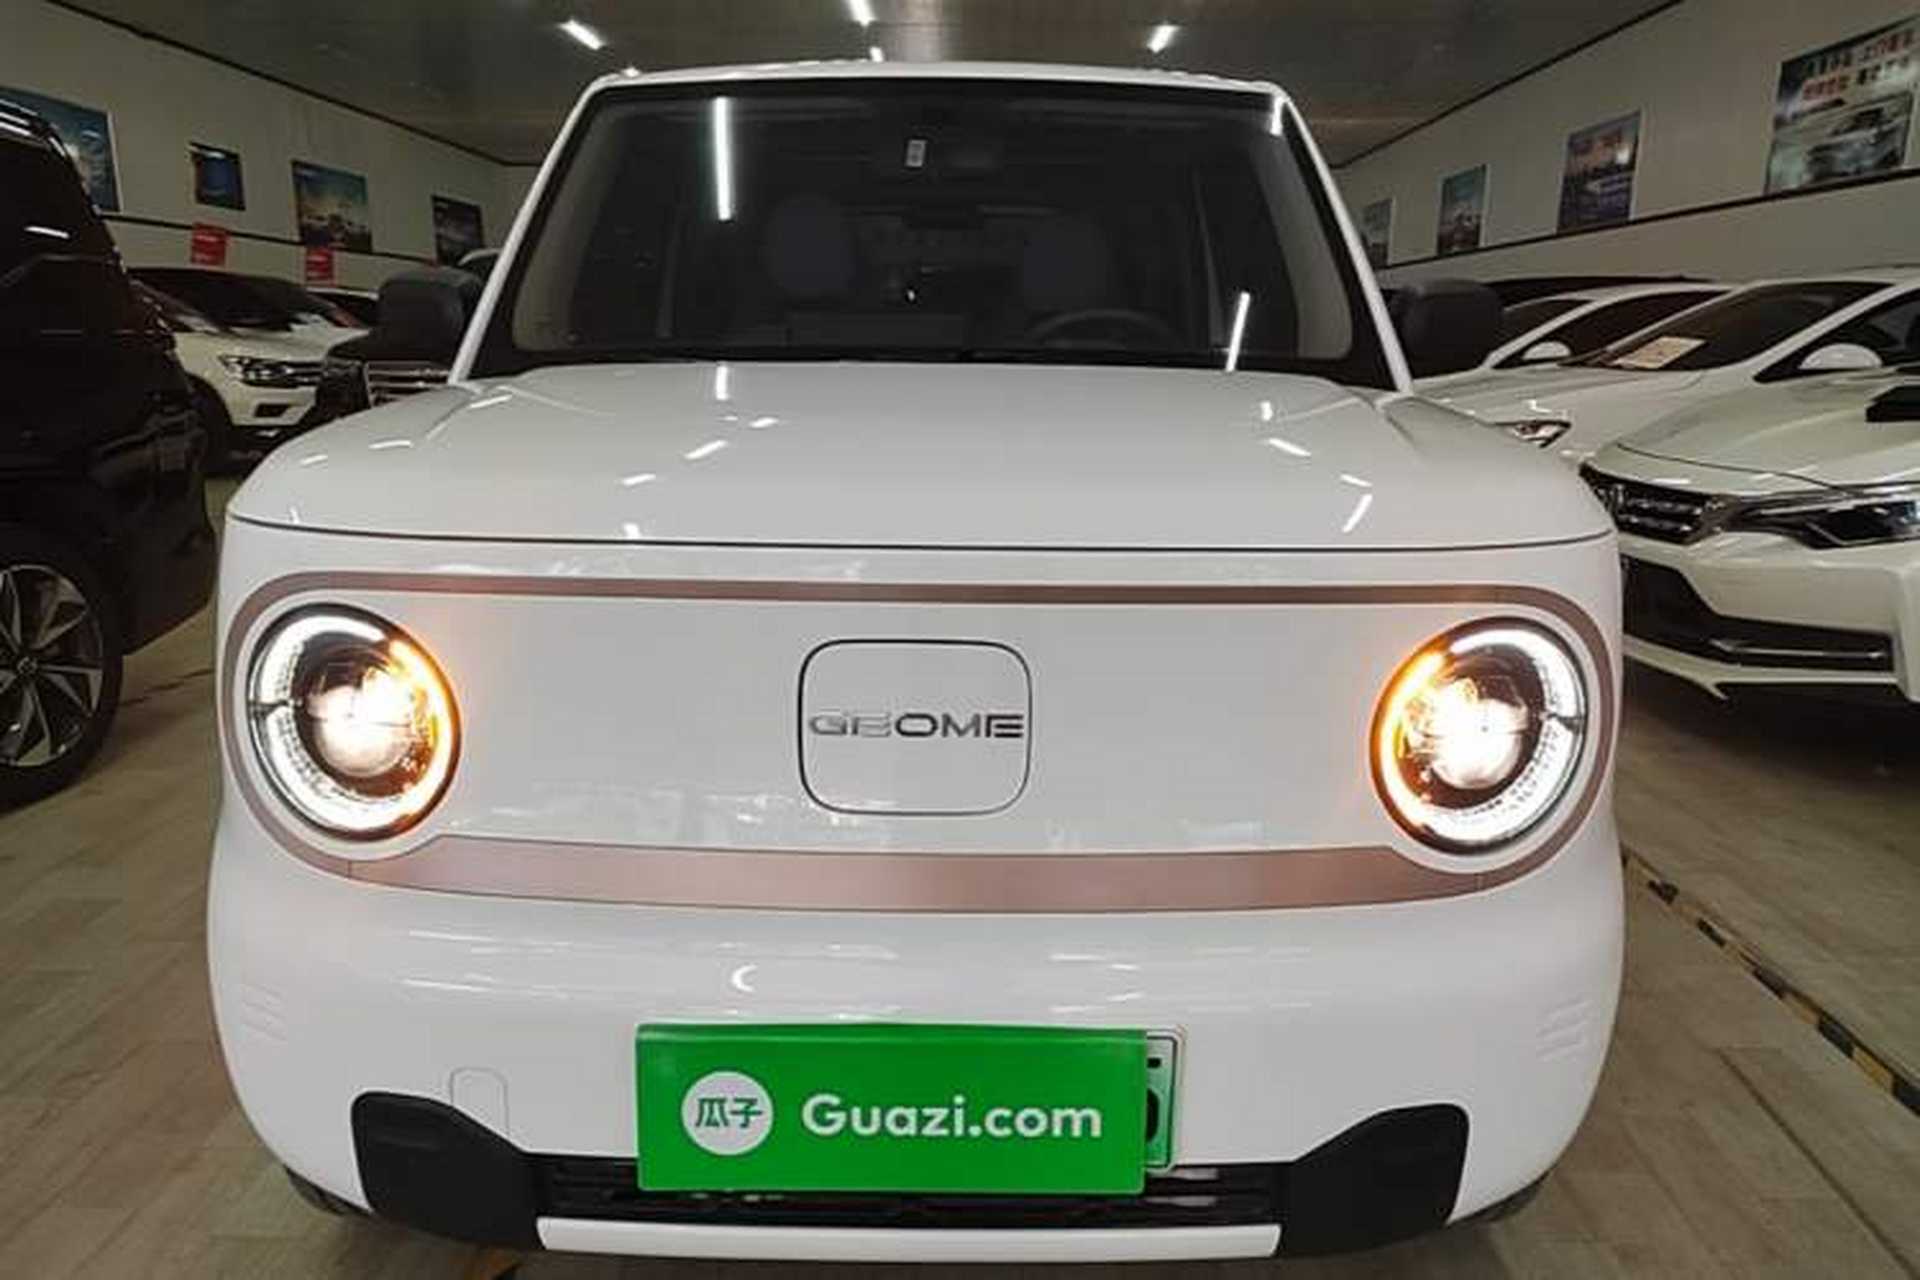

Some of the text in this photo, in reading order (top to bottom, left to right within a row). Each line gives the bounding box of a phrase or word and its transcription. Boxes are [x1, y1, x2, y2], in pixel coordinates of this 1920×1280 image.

[809, 713, 1024, 738] GEOME
[695, 1097, 763, 1129] 瓜子
[802, 1094, 1101, 1138] Guazi.com
